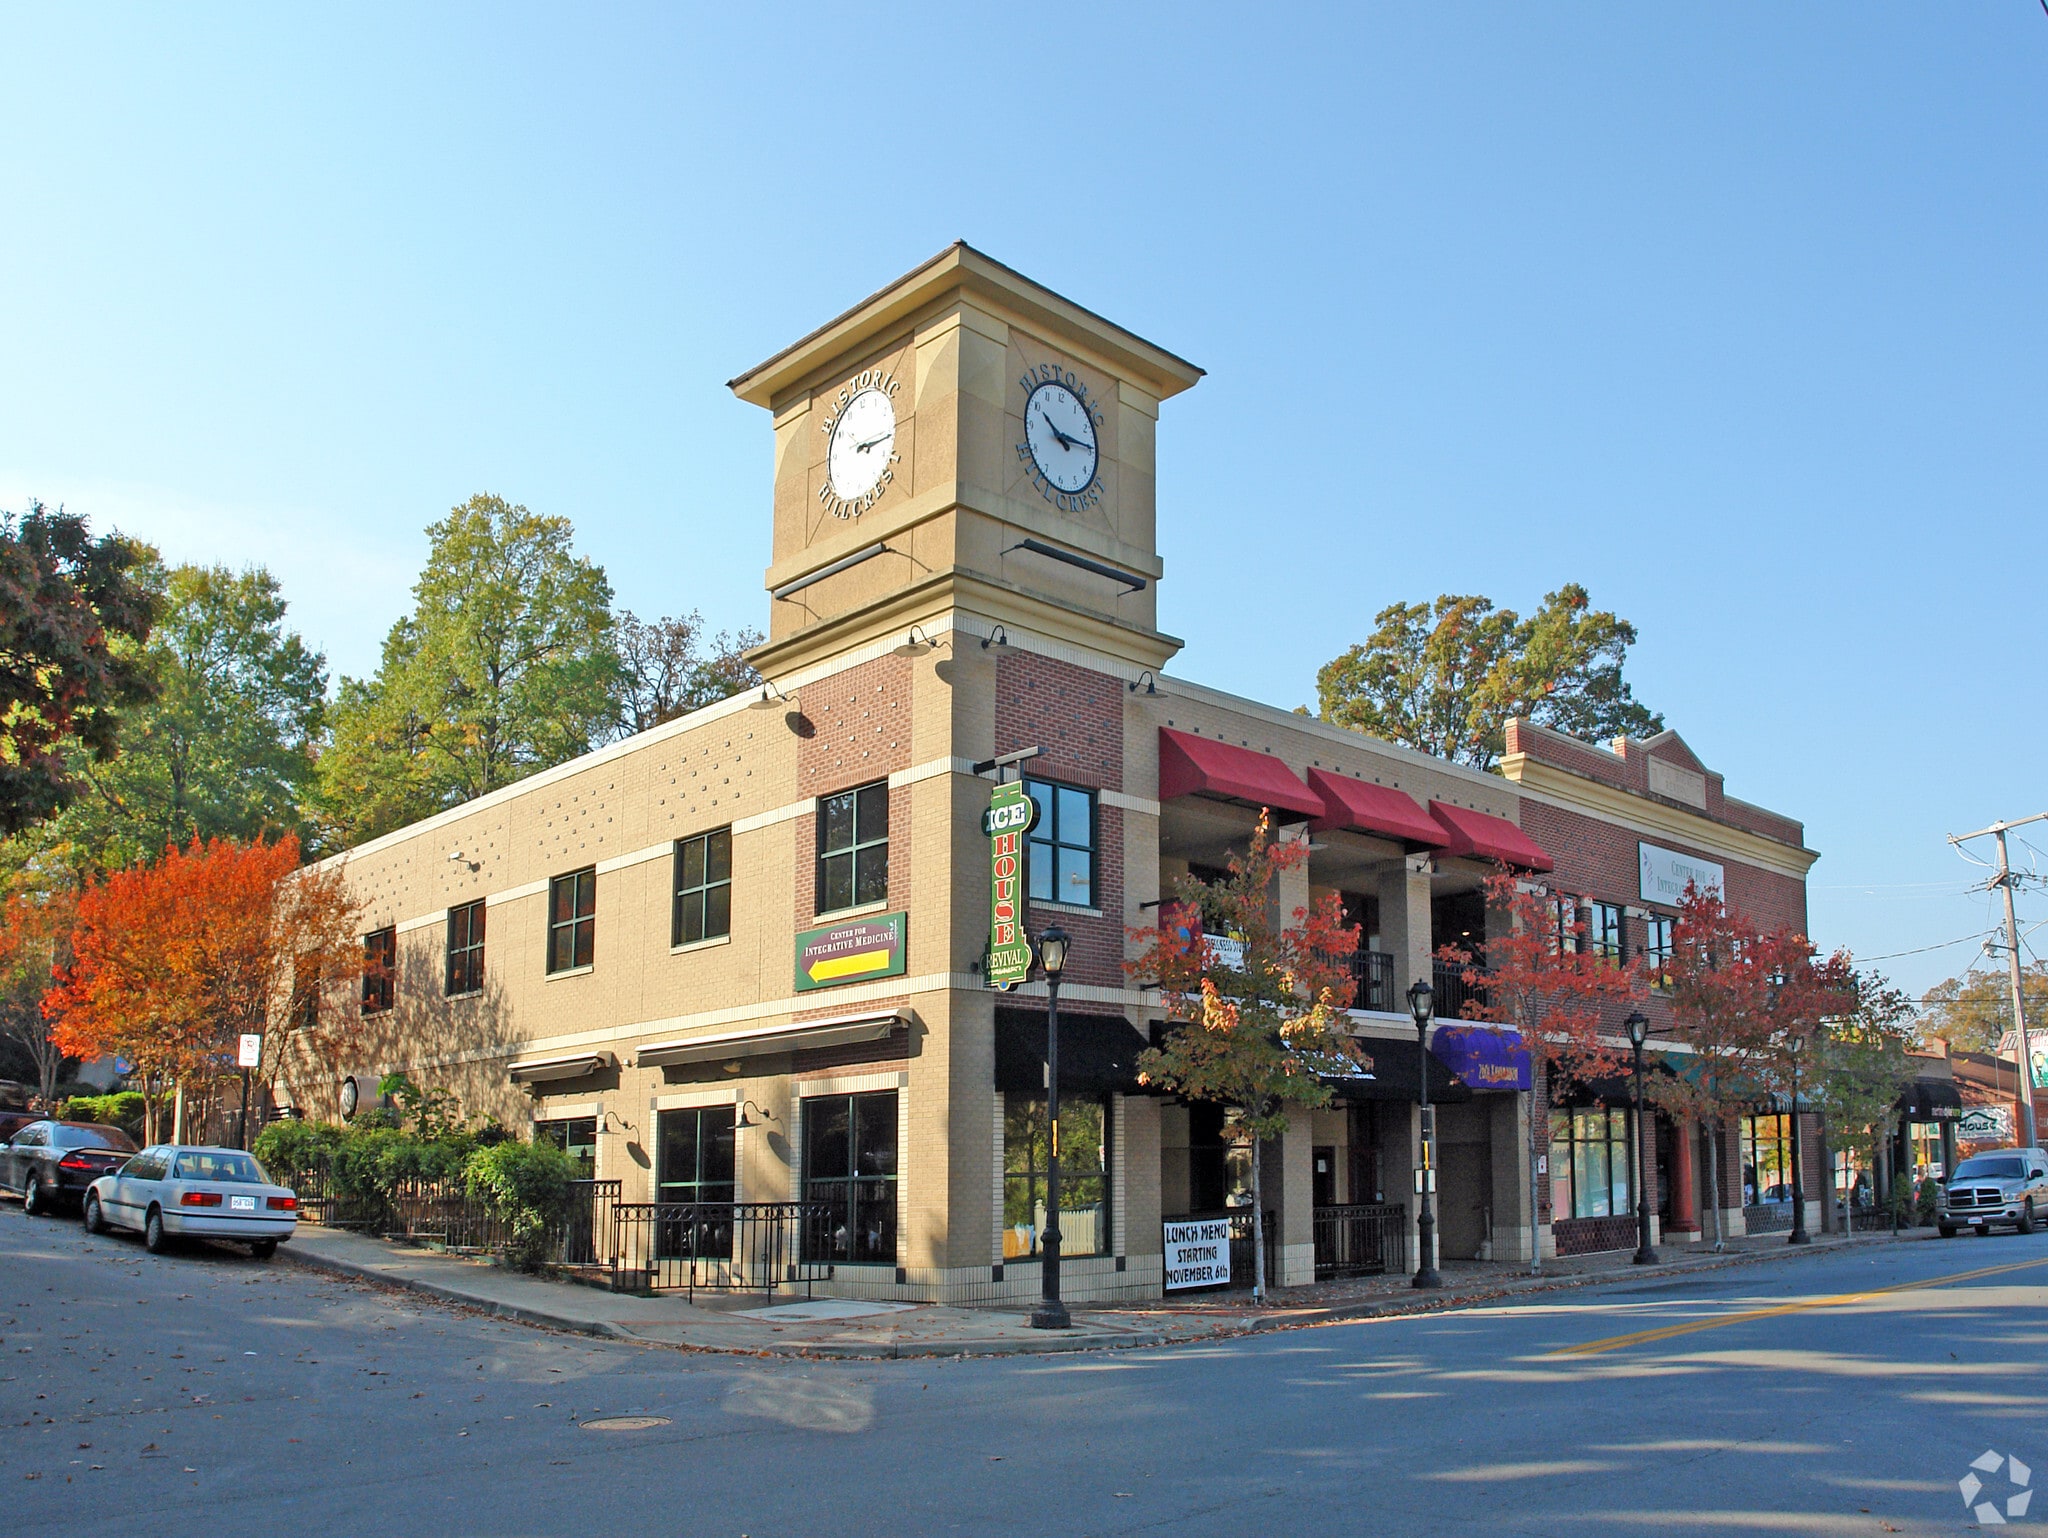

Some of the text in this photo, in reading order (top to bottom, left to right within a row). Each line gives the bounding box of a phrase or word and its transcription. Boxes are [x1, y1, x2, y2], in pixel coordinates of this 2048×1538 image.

[821, 369, 901, 436] HISTORIC
[1019, 363, 1104, 428] HISTORIC
[1057, 392, 1065, 403] 12
[1034, 401, 1041, 412] 10
[1083, 424, 1088, 433] 2
[818, 451, 901, 520] HILLCREST
[1016, 441, 1105, 513] HILLCREST
[986, 802, 1027, 832] ICE
[1671, 860, 1693, 879] CENTER
[993, 831, 1018, 947] HOUSE
[830, 927, 866, 940] CENTER FOR
[805, 931, 894, 957] INTEGRATIVE MEDICINE
[986, 949, 1023, 969] REVIVAL
[1166, 1223, 1227, 1244] LUNCH MENU
[1177, 1246, 1217, 1263] STARTING
[1166, 1265, 1228, 1285] NOVEMBER 6th
